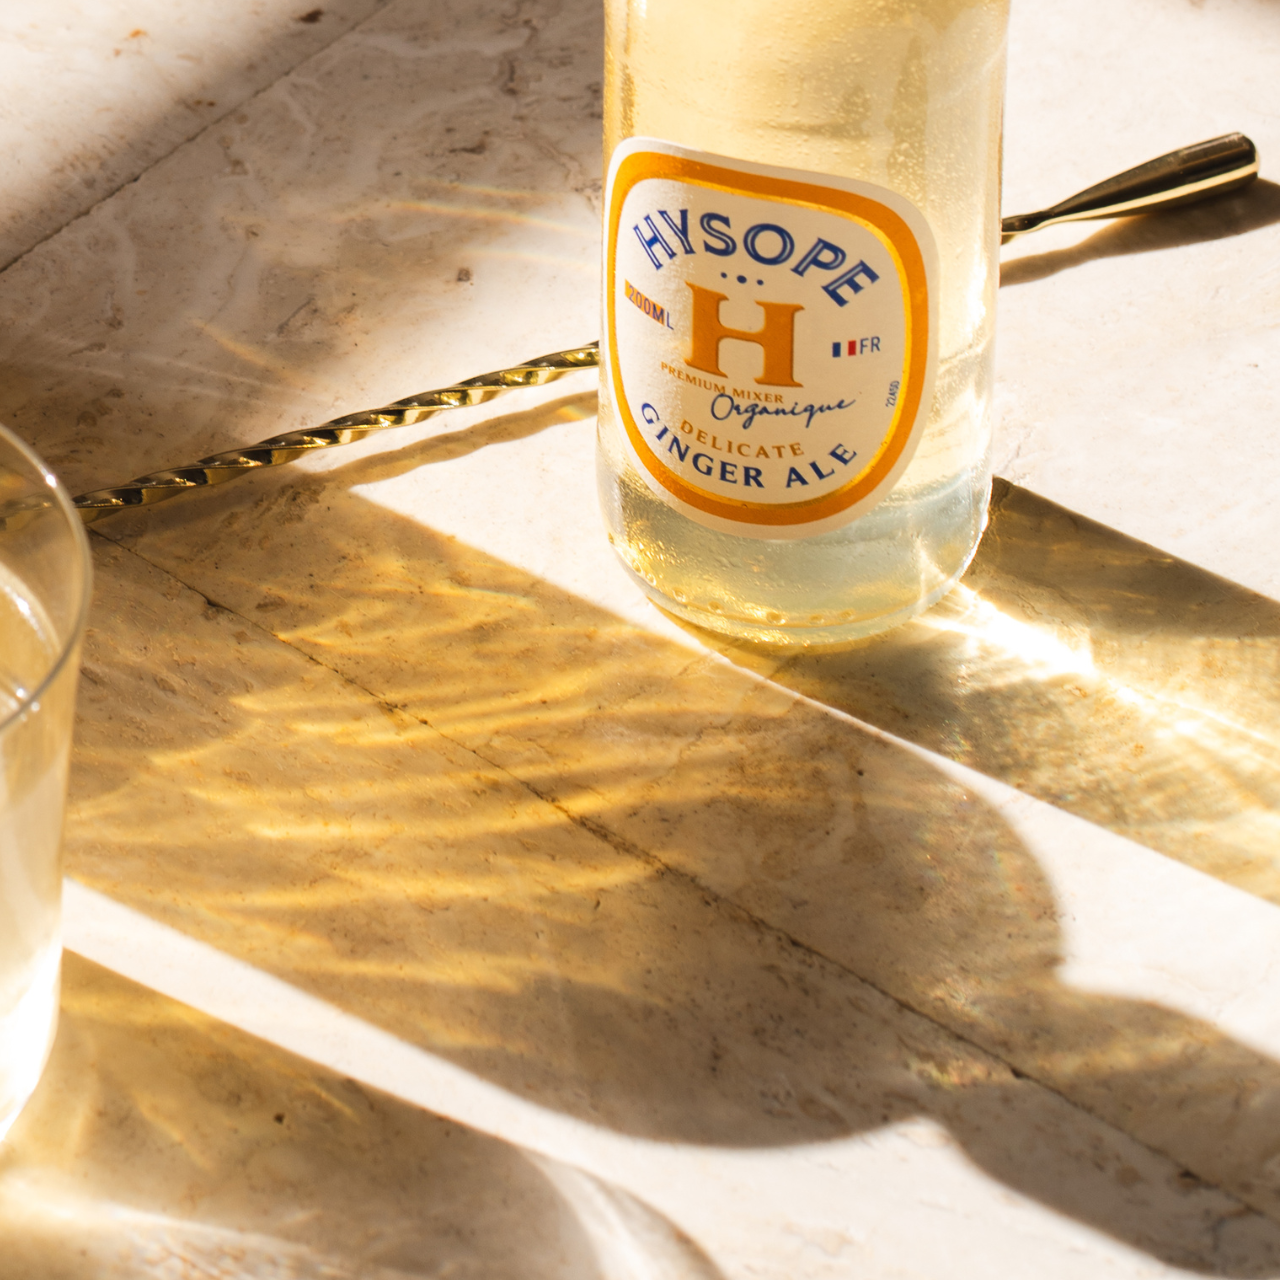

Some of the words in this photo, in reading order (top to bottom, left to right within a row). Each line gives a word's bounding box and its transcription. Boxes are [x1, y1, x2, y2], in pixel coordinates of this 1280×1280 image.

[632, 208, 880, 308] HYSOPE
[628, 284, 675, 331] 200ML
[859, 336, 881, 355] FR
[683, 280, 805, 388] H
[660, 361, 726, 395] PREMIUM
[732, 387, 785, 404] MIXER
[710, 393, 857, 430] Organique
[641, 402, 766, 488] GINGER
[784, 442, 858, 488] ALE
[680, 418, 805, 460] DELICATE
